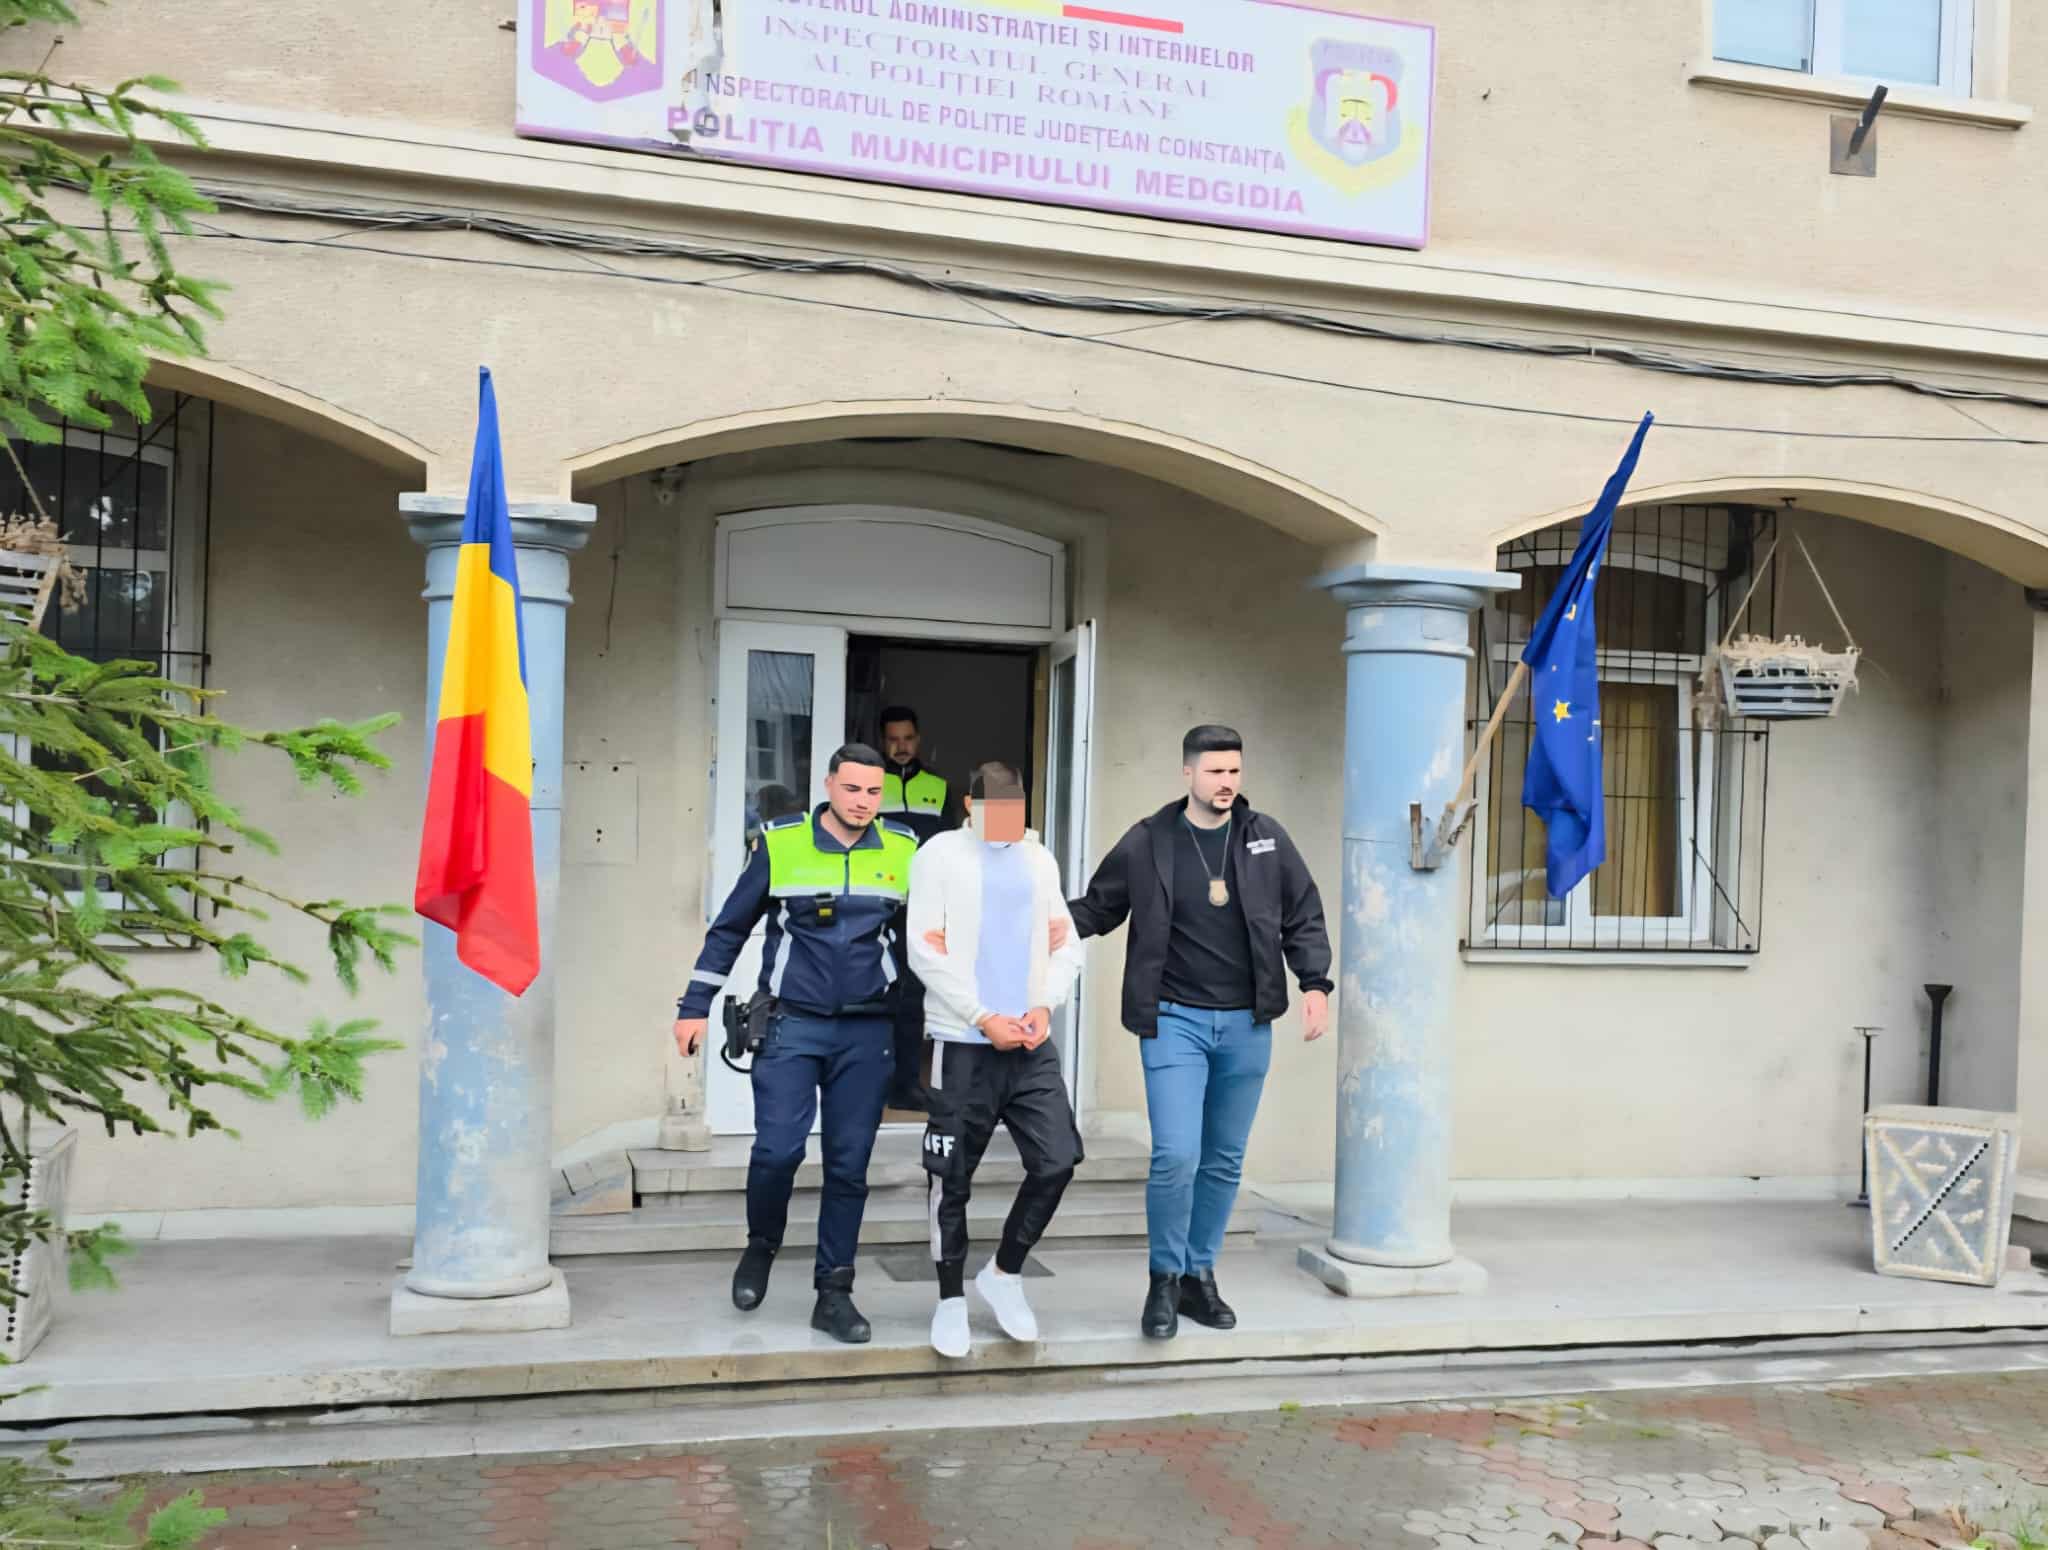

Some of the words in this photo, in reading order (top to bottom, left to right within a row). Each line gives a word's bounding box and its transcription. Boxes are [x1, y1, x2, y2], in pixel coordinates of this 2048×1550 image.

[763, 15, 1047, 75] INSPECTORATUL
[1065, 60, 1216, 99] GENERAL
[810, 53, 850, 75] AL
[1038, 84, 1176, 119] ROMÂNE
[1119, 34, 1254, 73] INTERNELOR
[902, 101, 930, 123] DE
[851, 131, 1110, 190] MUNICIPIULUI
[1135, 168, 1305, 213] MEDGIDIA
